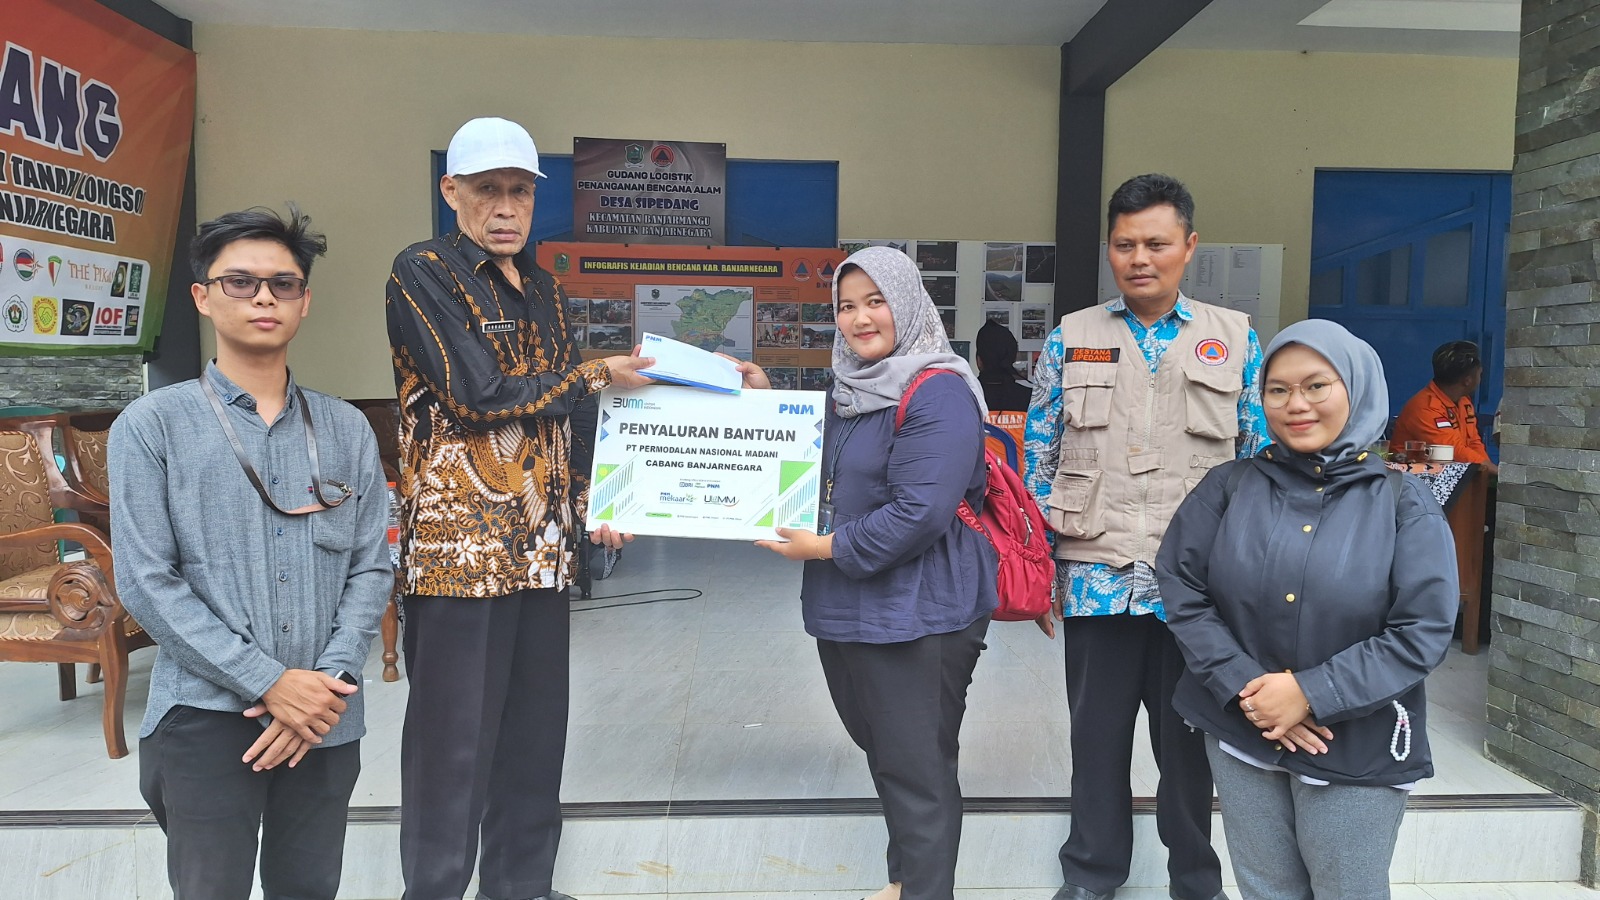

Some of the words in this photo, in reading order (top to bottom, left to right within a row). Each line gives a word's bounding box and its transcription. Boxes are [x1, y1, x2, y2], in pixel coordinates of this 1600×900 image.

[608, 170, 648, 180] GUDANG
[650, 172, 693, 182] LOGISTIK
[578, 181, 644, 191] PENANGANAN
[646, 184, 692, 193] BENCANA
[694, 186, 721, 194] ALAM
[75, 173, 147, 216] LONGSO
[600, 196, 632, 208] DESA
[635, 197, 699, 210] SIPEDANG
[589, 212, 642, 223] KECAMATAN
[644, 214, 710, 225] BANJARMANGU
[586, 224, 639, 234] KABUPATEN
[642, 226, 712, 238] BANJARNEGARA
[67, 259, 90, 280] THE
[584, 261, 628, 271] INFOGRAFIS
[630, 262, 665, 271] KEJADIAN
[666, 263, 701, 272] BENCANA
[703, 264, 720, 272] KAB.
[721, 264, 778, 273] BANJARNEGARA
[95, 307, 124, 325] IOF
[613, 398, 643, 409] BUMN
[779, 403, 814, 415] PNM
[619, 422, 719, 439] PENYALURAN
[724, 428, 796, 442] BANTUAN
[639, 445, 697, 455] PERMODALAN
[699, 448, 745, 457] NASIONAL
[746, 450, 778, 458] MADANI
[646, 460, 684, 468] CABANG
[687, 461, 762, 472] BANJARNEGARA
